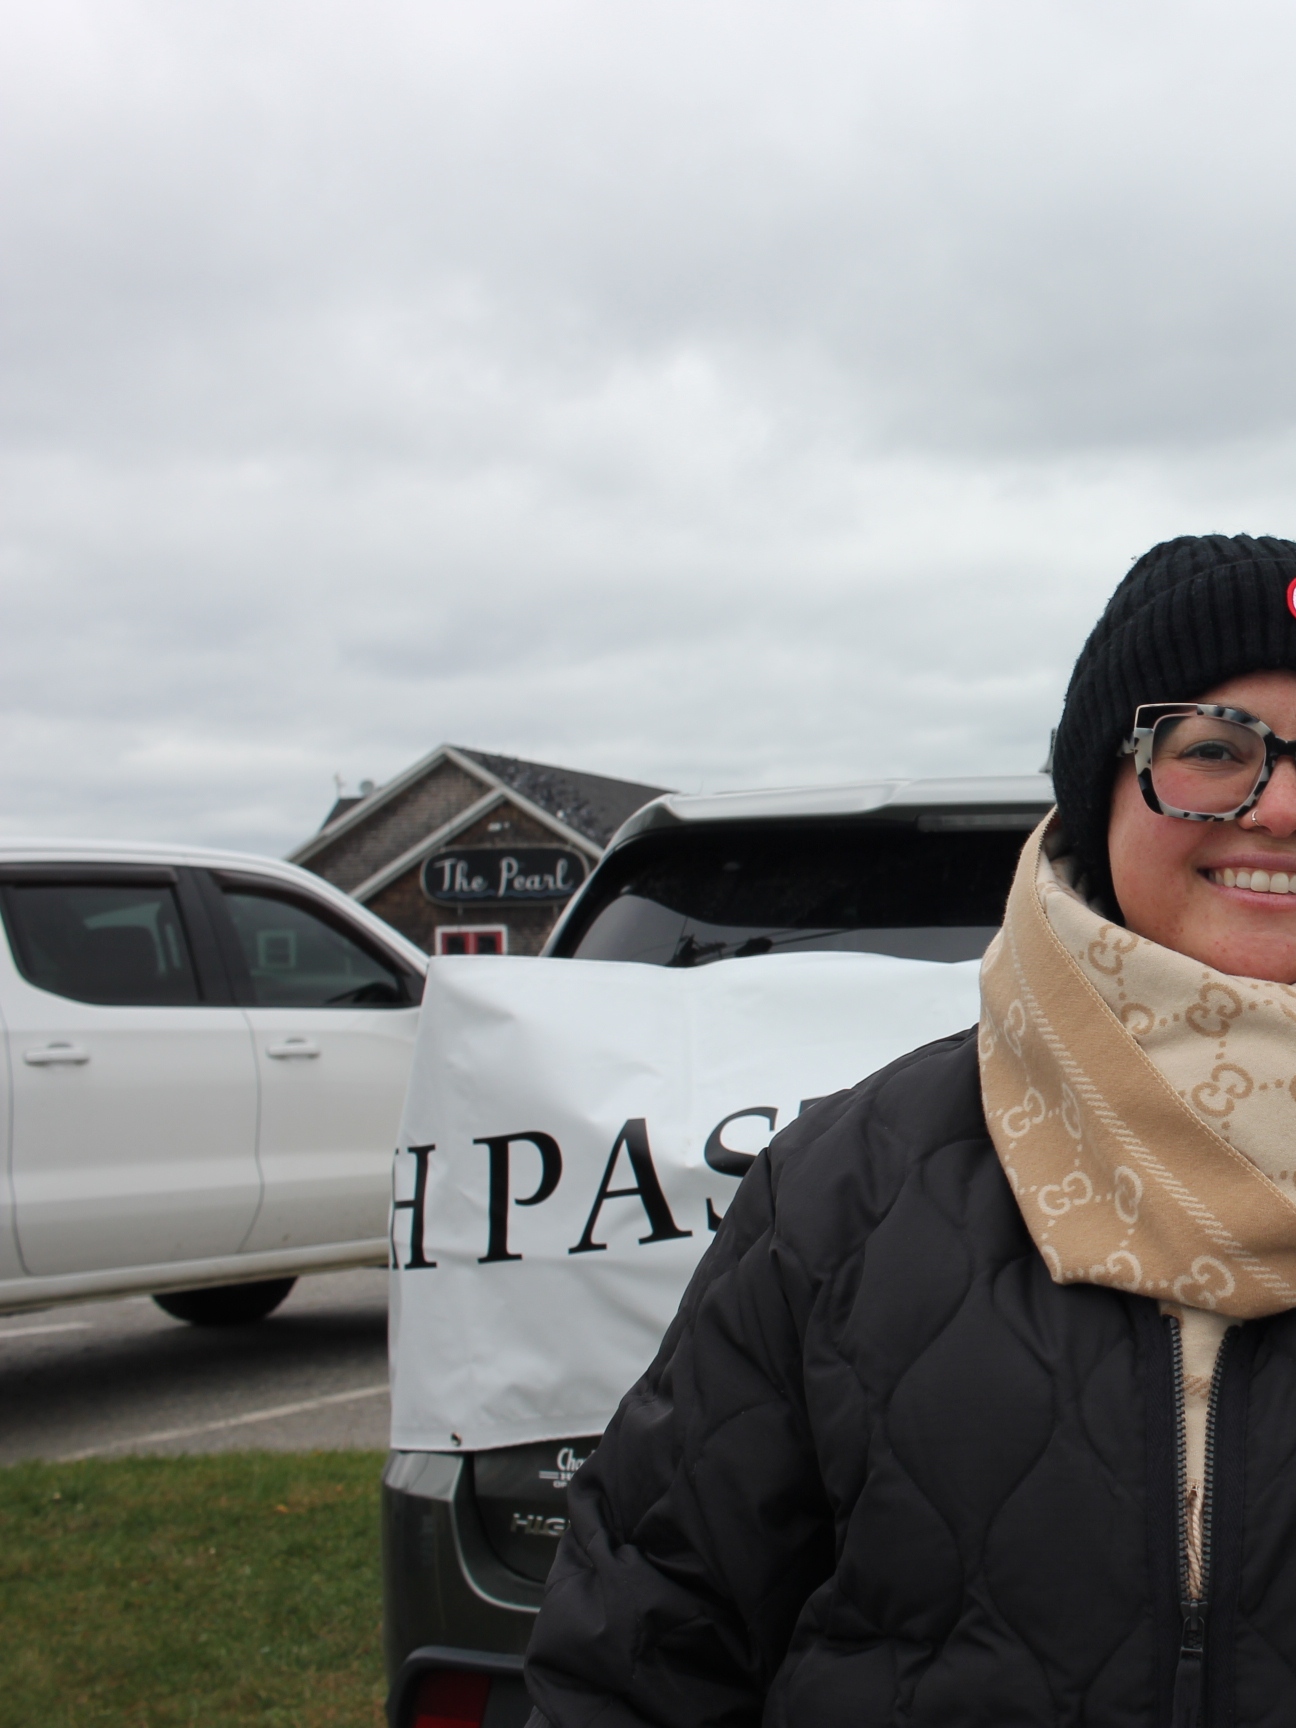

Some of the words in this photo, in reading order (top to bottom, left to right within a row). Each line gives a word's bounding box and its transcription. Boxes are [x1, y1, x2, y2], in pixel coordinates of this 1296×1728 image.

[433, 857, 489, 892] The
[497, 856, 574, 898] Pearl
[472, 1096, 827, 1264] PAS
[510, 1512, 571, 1537] HIG
